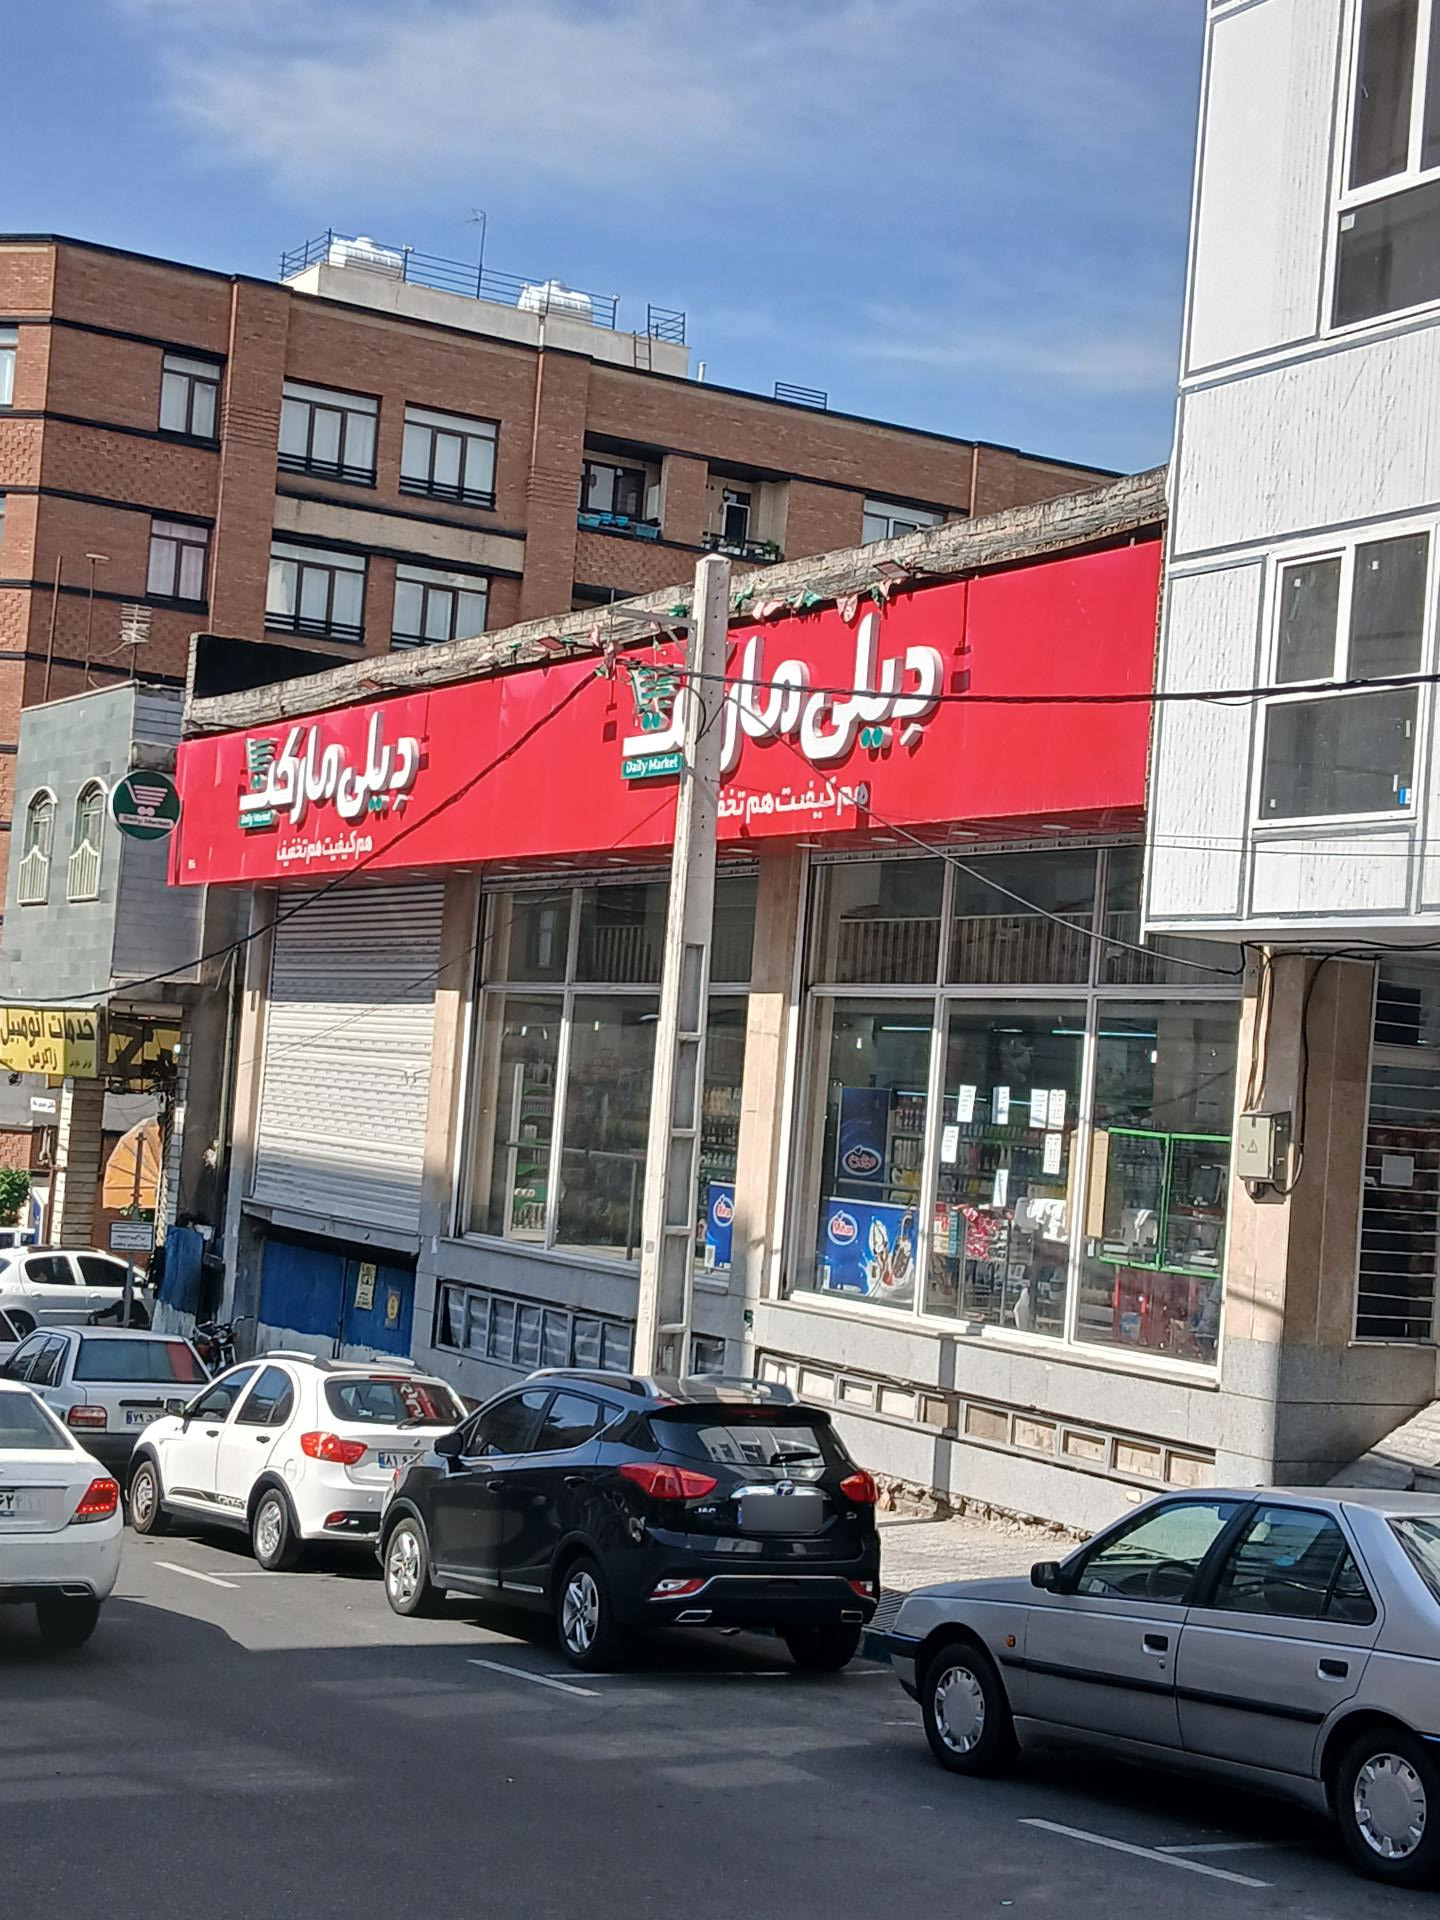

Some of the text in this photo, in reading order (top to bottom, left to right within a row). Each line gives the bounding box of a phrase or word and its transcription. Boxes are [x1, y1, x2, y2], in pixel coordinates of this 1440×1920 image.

[800, 612, 943, 760] دیلی
[239, 711, 420, 824] دیلی مارکت
[626, 755, 678, 777] Daily Market
[745, 793, 775, 824] هم
[305, 840, 321, 864] هم
[322, 830, 357, 862] کیفیت
[354, 835, 373, 860] هم
[0, 1007, 95, 1048] خدمات اتومبیل
